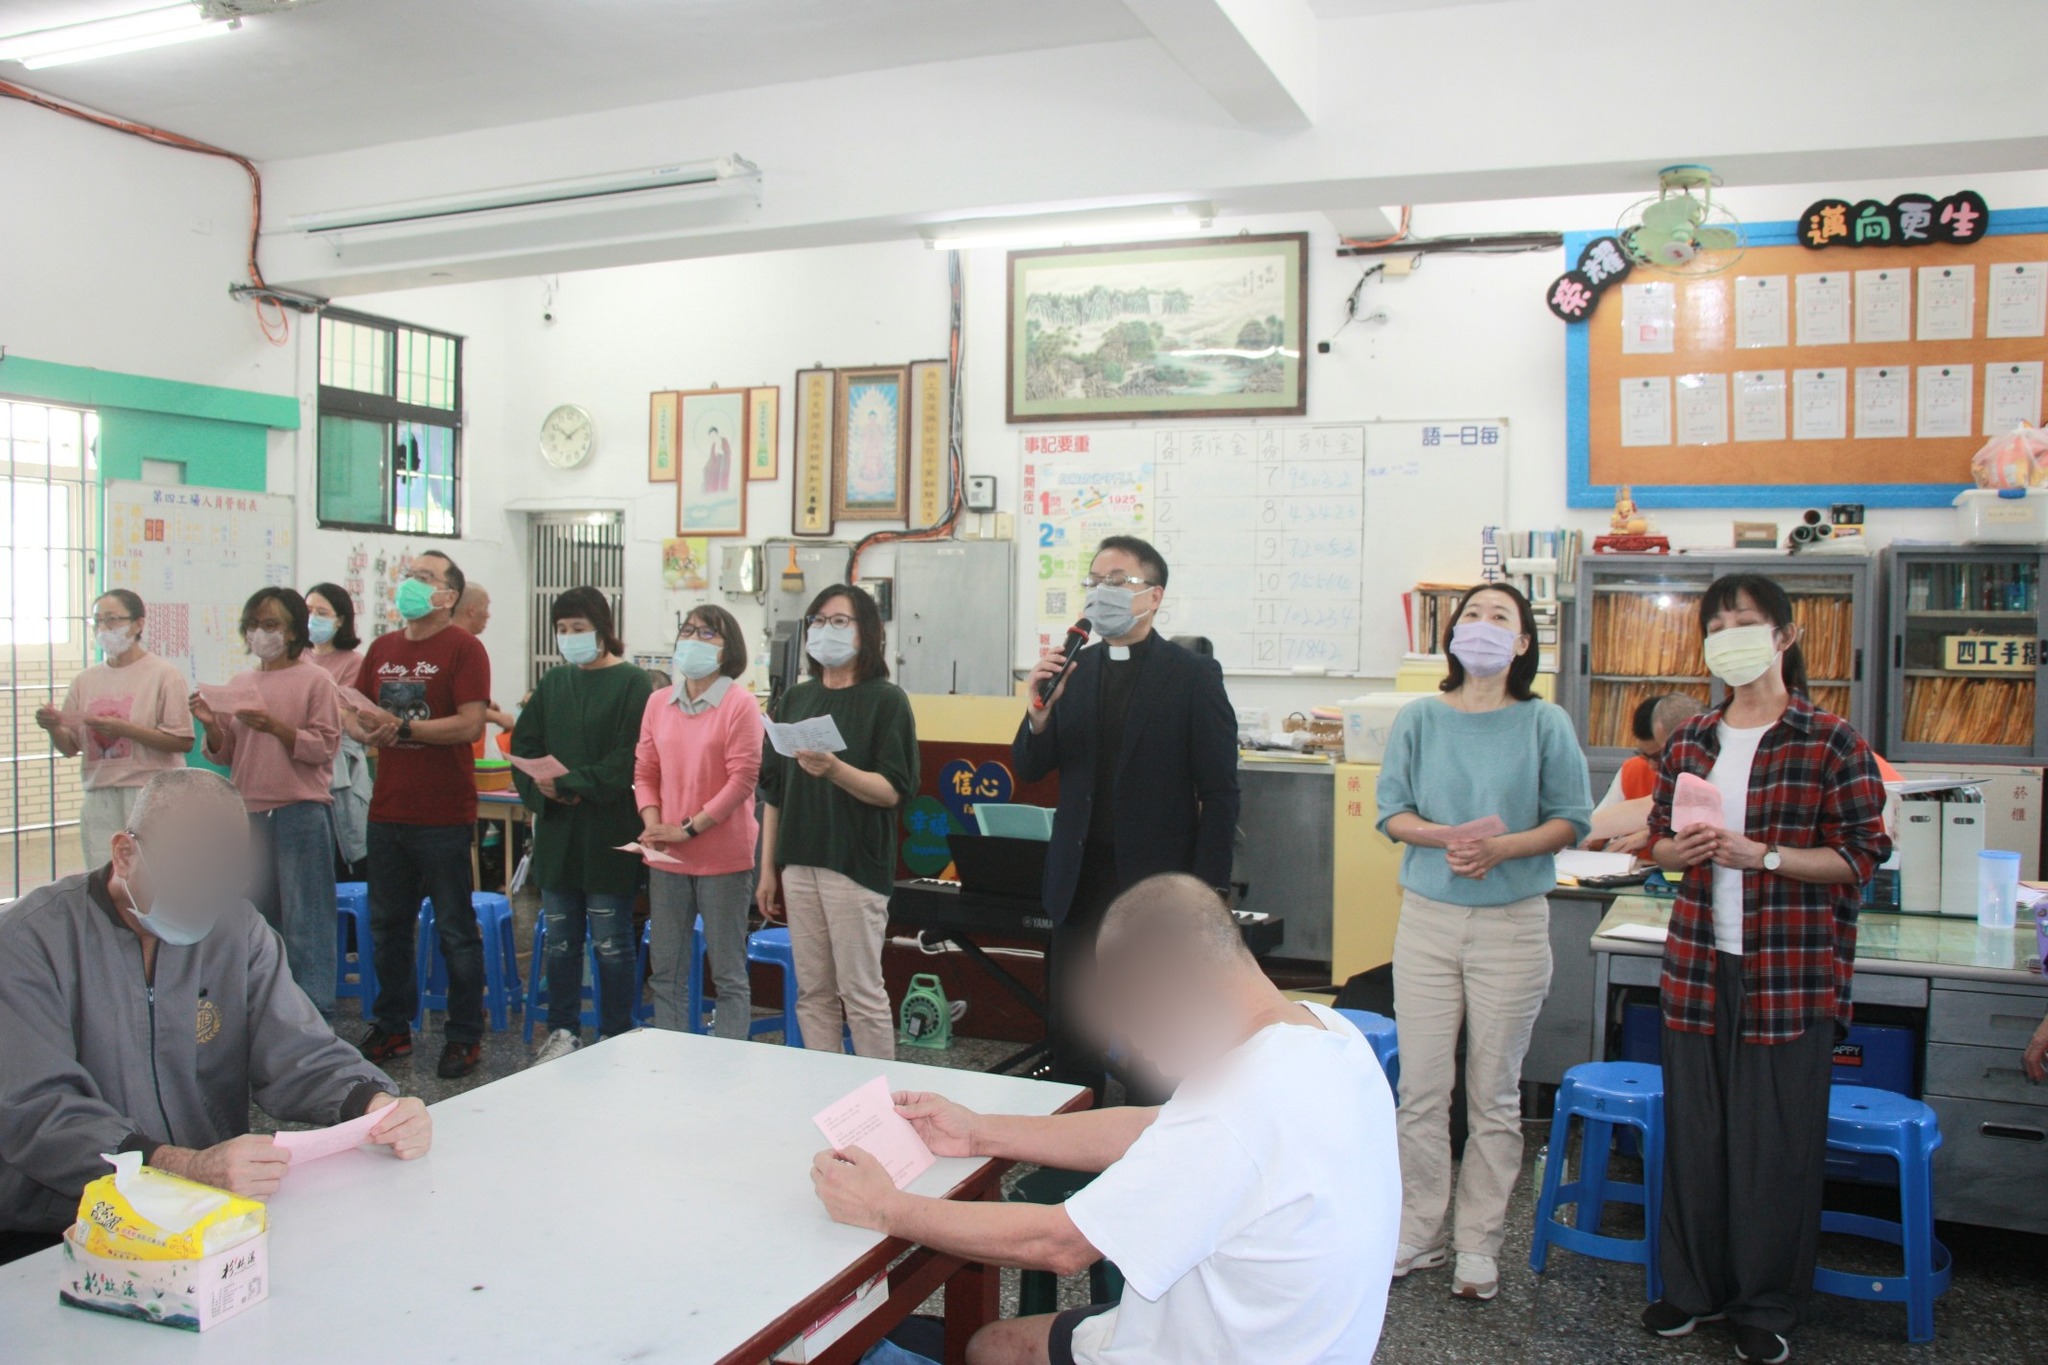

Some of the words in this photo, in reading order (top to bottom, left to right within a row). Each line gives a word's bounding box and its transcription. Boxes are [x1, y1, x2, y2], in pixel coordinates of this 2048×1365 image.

[1808, 201, 1979, 245] 邁向更生
[1163, 472, 1171, 491] 1
[1264, 466, 1278, 486] 7
[1040, 491, 1050, 515] 1
[1108, 495, 1136, 504] 1925
[1158, 502, 1173, 523] 2
[1262, 499, 1277, 523] 8
[1039, 522, 1054, 547] 2
[1161, 535, 1173, 555] 3
[1263, 537, 1276, 560] 9
[1039, 555, 1053, 579] 3
[1259, 573, 1279, 592] 10
[1159, 606, 1171, 625] 5
[1258, 604, 1276, 624] 11
[1258, 640, 1275, 661] 12
[952, 770, 998, 797] 信心
[1347, 776, 1362, 817] 藥櫃
[911, 810, 949, 836] 幸福
[1833, 1045, 1861, 1055] APPY
